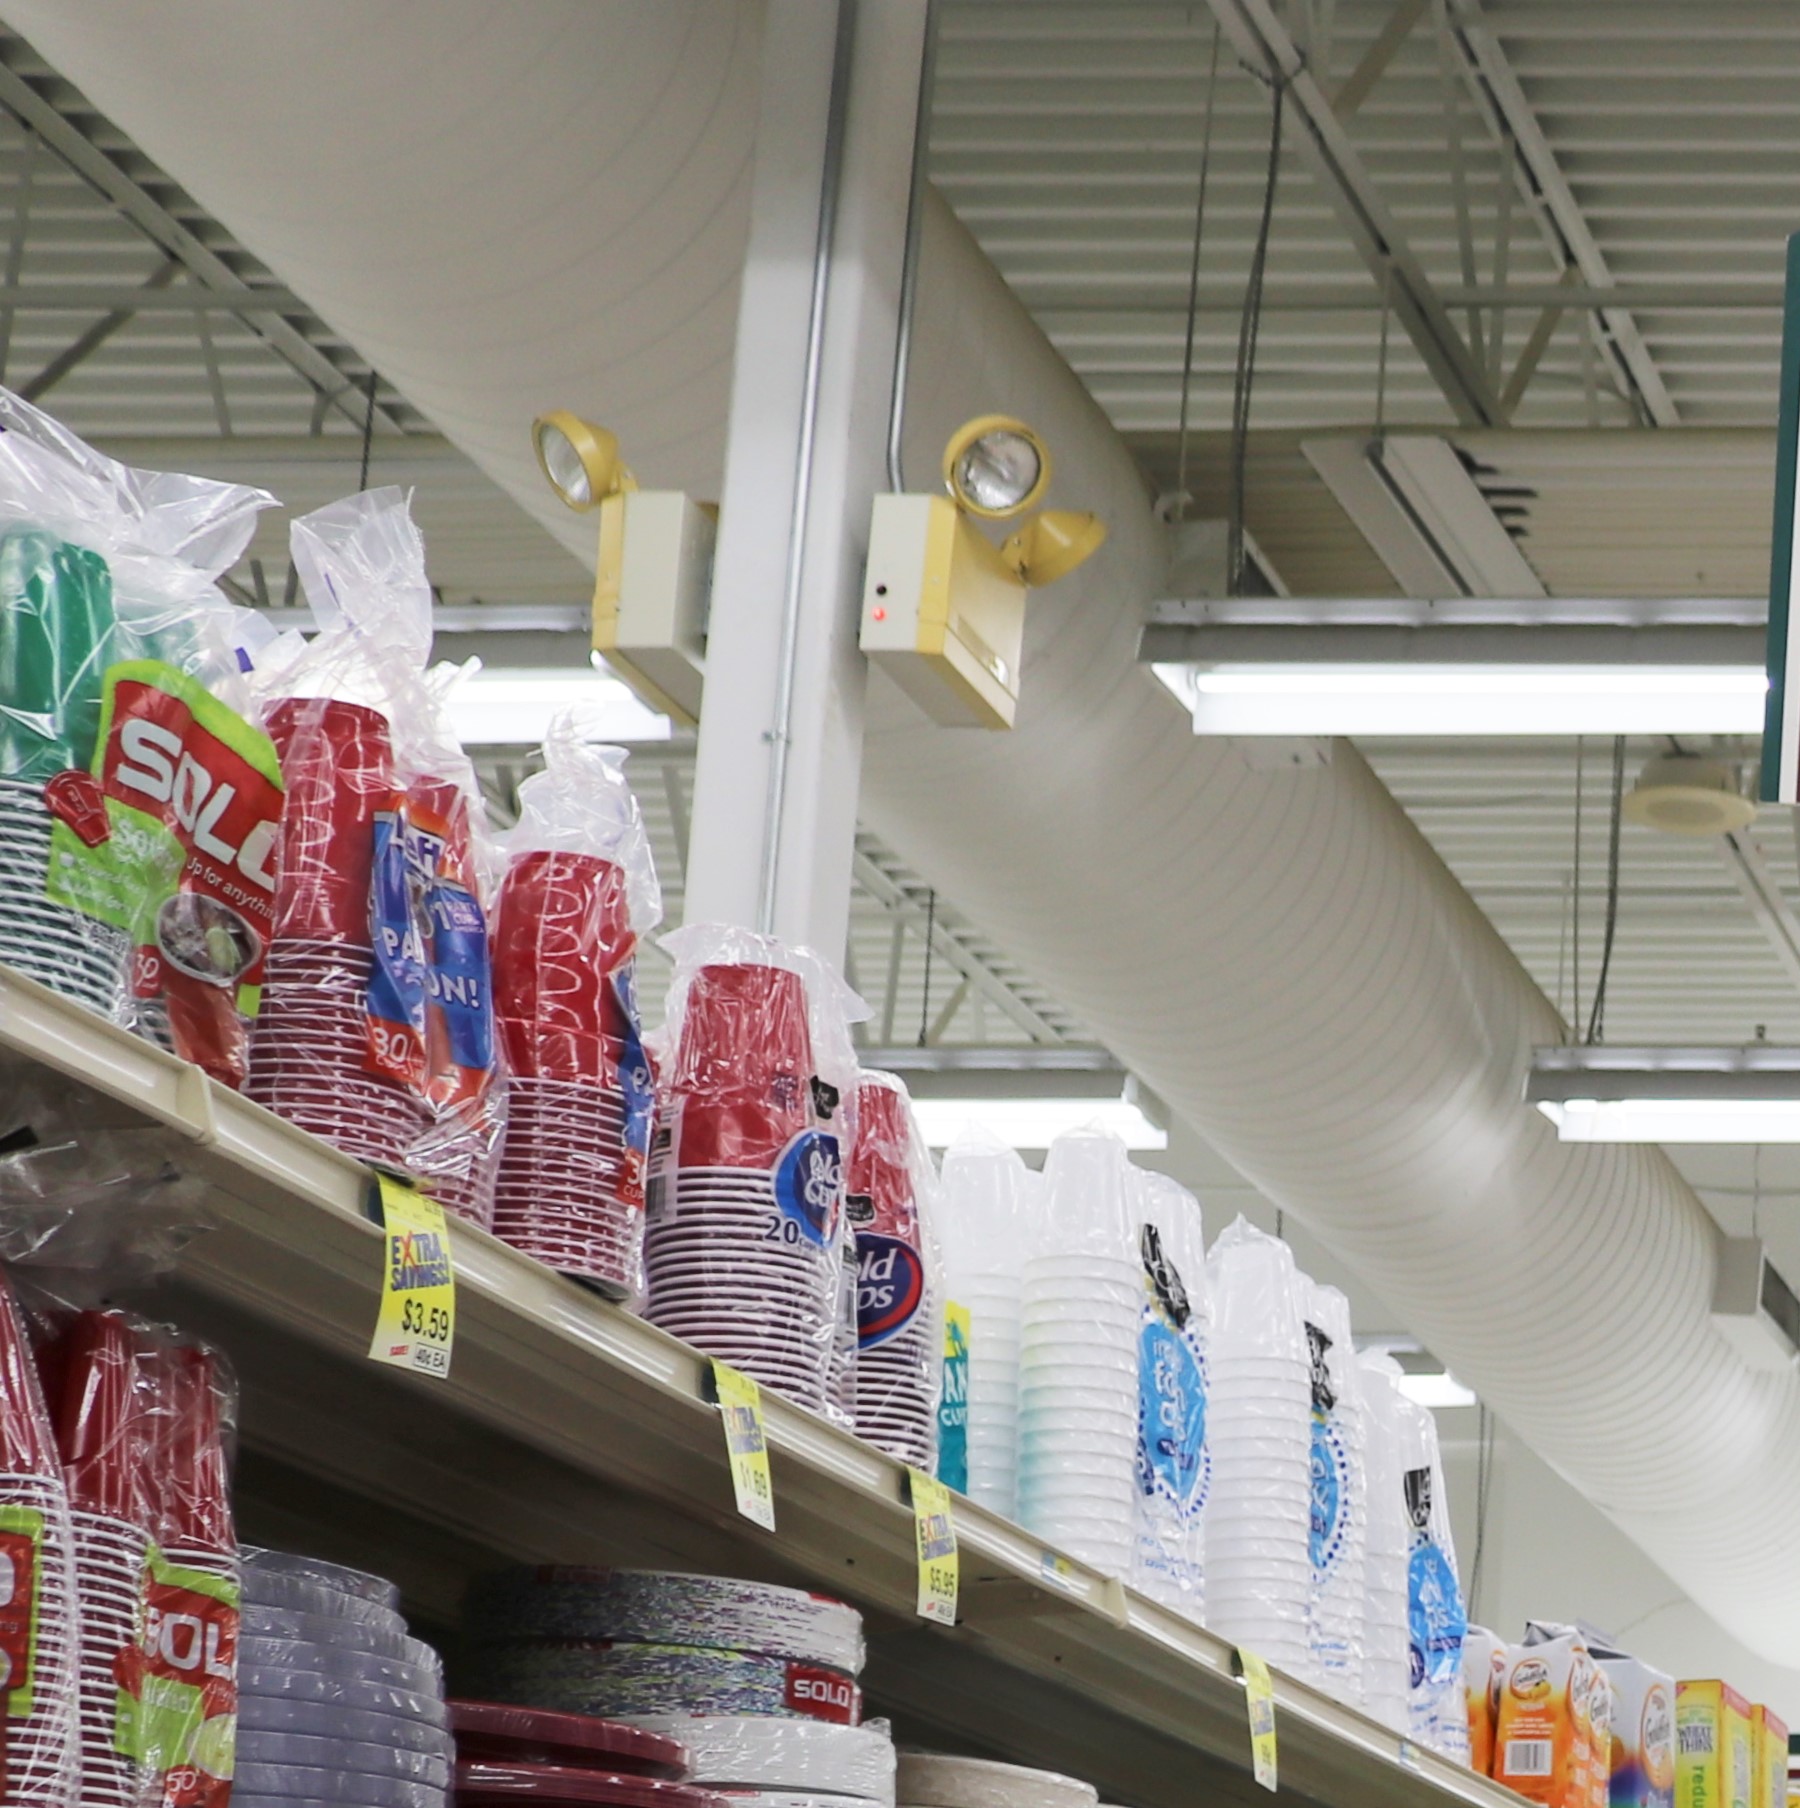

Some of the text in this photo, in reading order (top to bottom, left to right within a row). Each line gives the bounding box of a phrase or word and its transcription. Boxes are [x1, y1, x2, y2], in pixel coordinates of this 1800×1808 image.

[765, 1215, 799, 1243] 20
[392, 1231, 443, 1266] EXTRA
[402, 1298, 448, 1342] $3.59
[793, 1675, 850, 1708] SOLO
